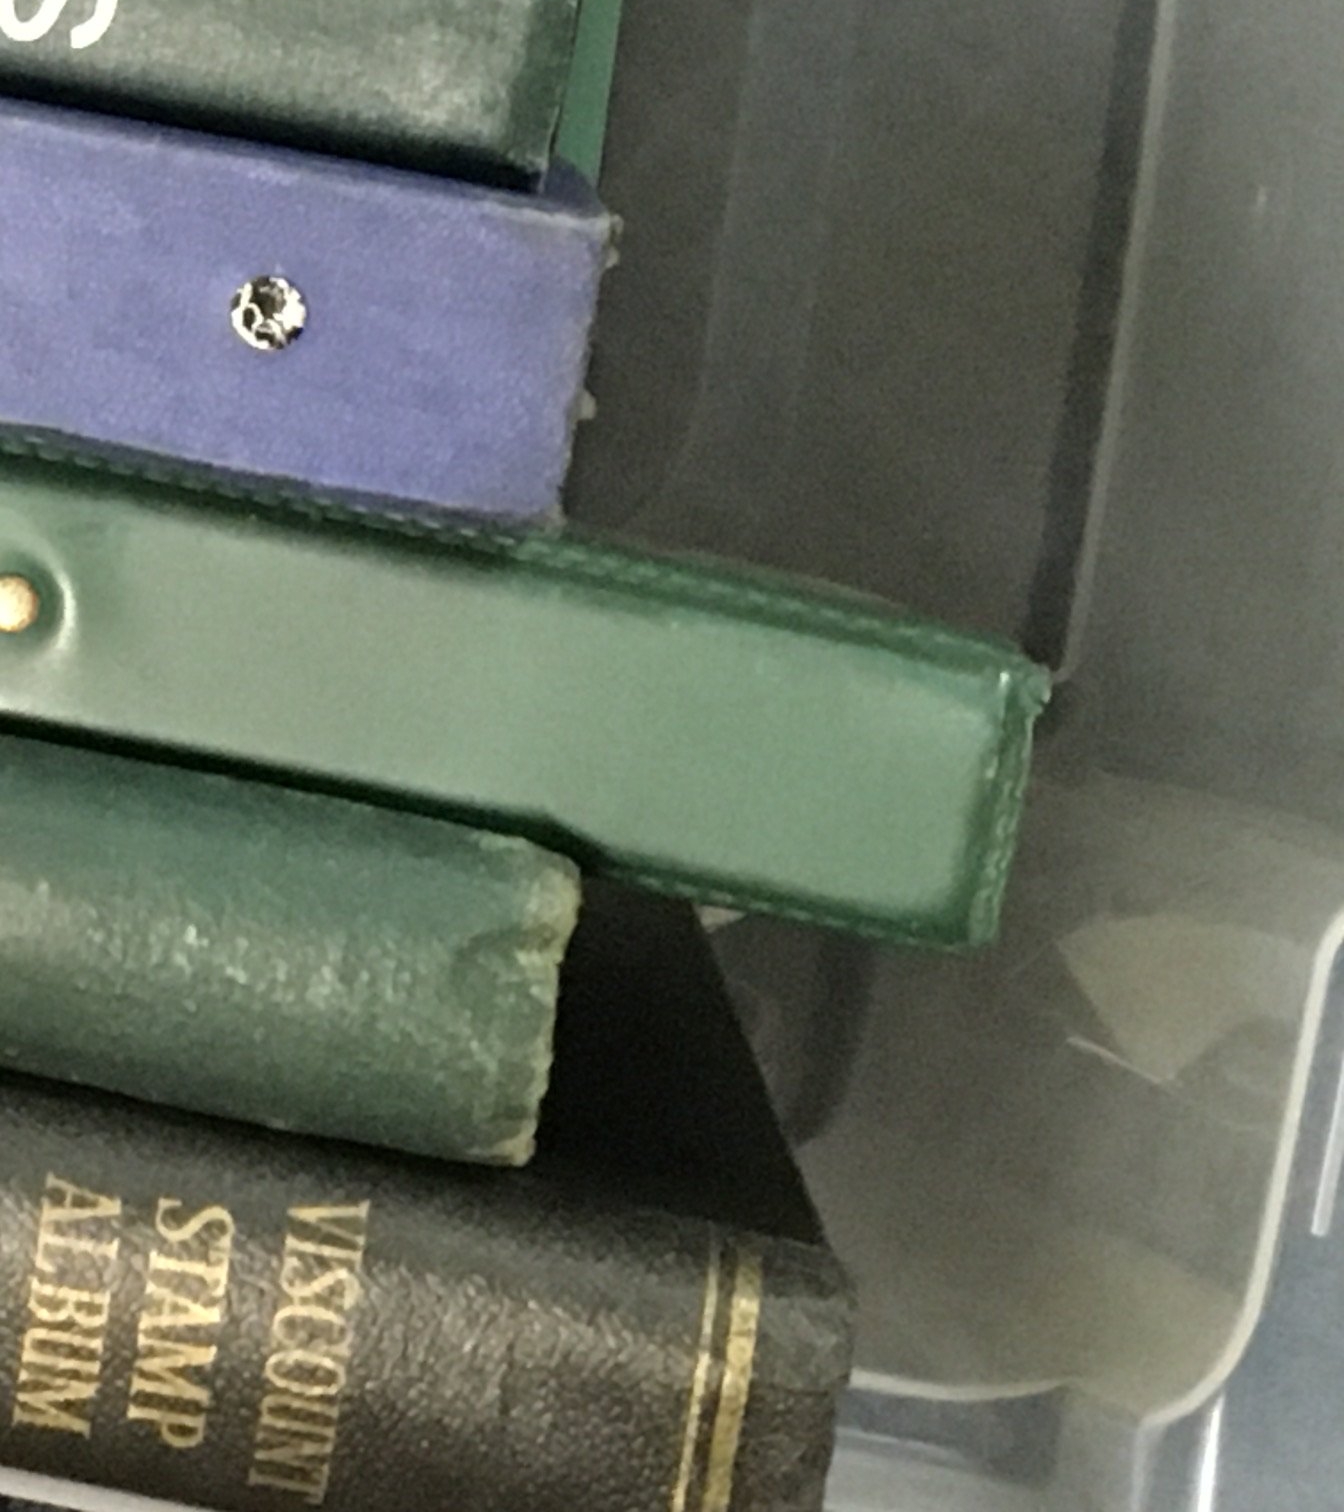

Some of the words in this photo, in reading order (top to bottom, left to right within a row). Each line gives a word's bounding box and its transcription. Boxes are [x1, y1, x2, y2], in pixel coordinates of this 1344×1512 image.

[12, 1172, 122, 1440] ALBUM
[126, 1197, 236, 1449] STAMP
[248, 1199, 371, 1505] VISCOUNT
